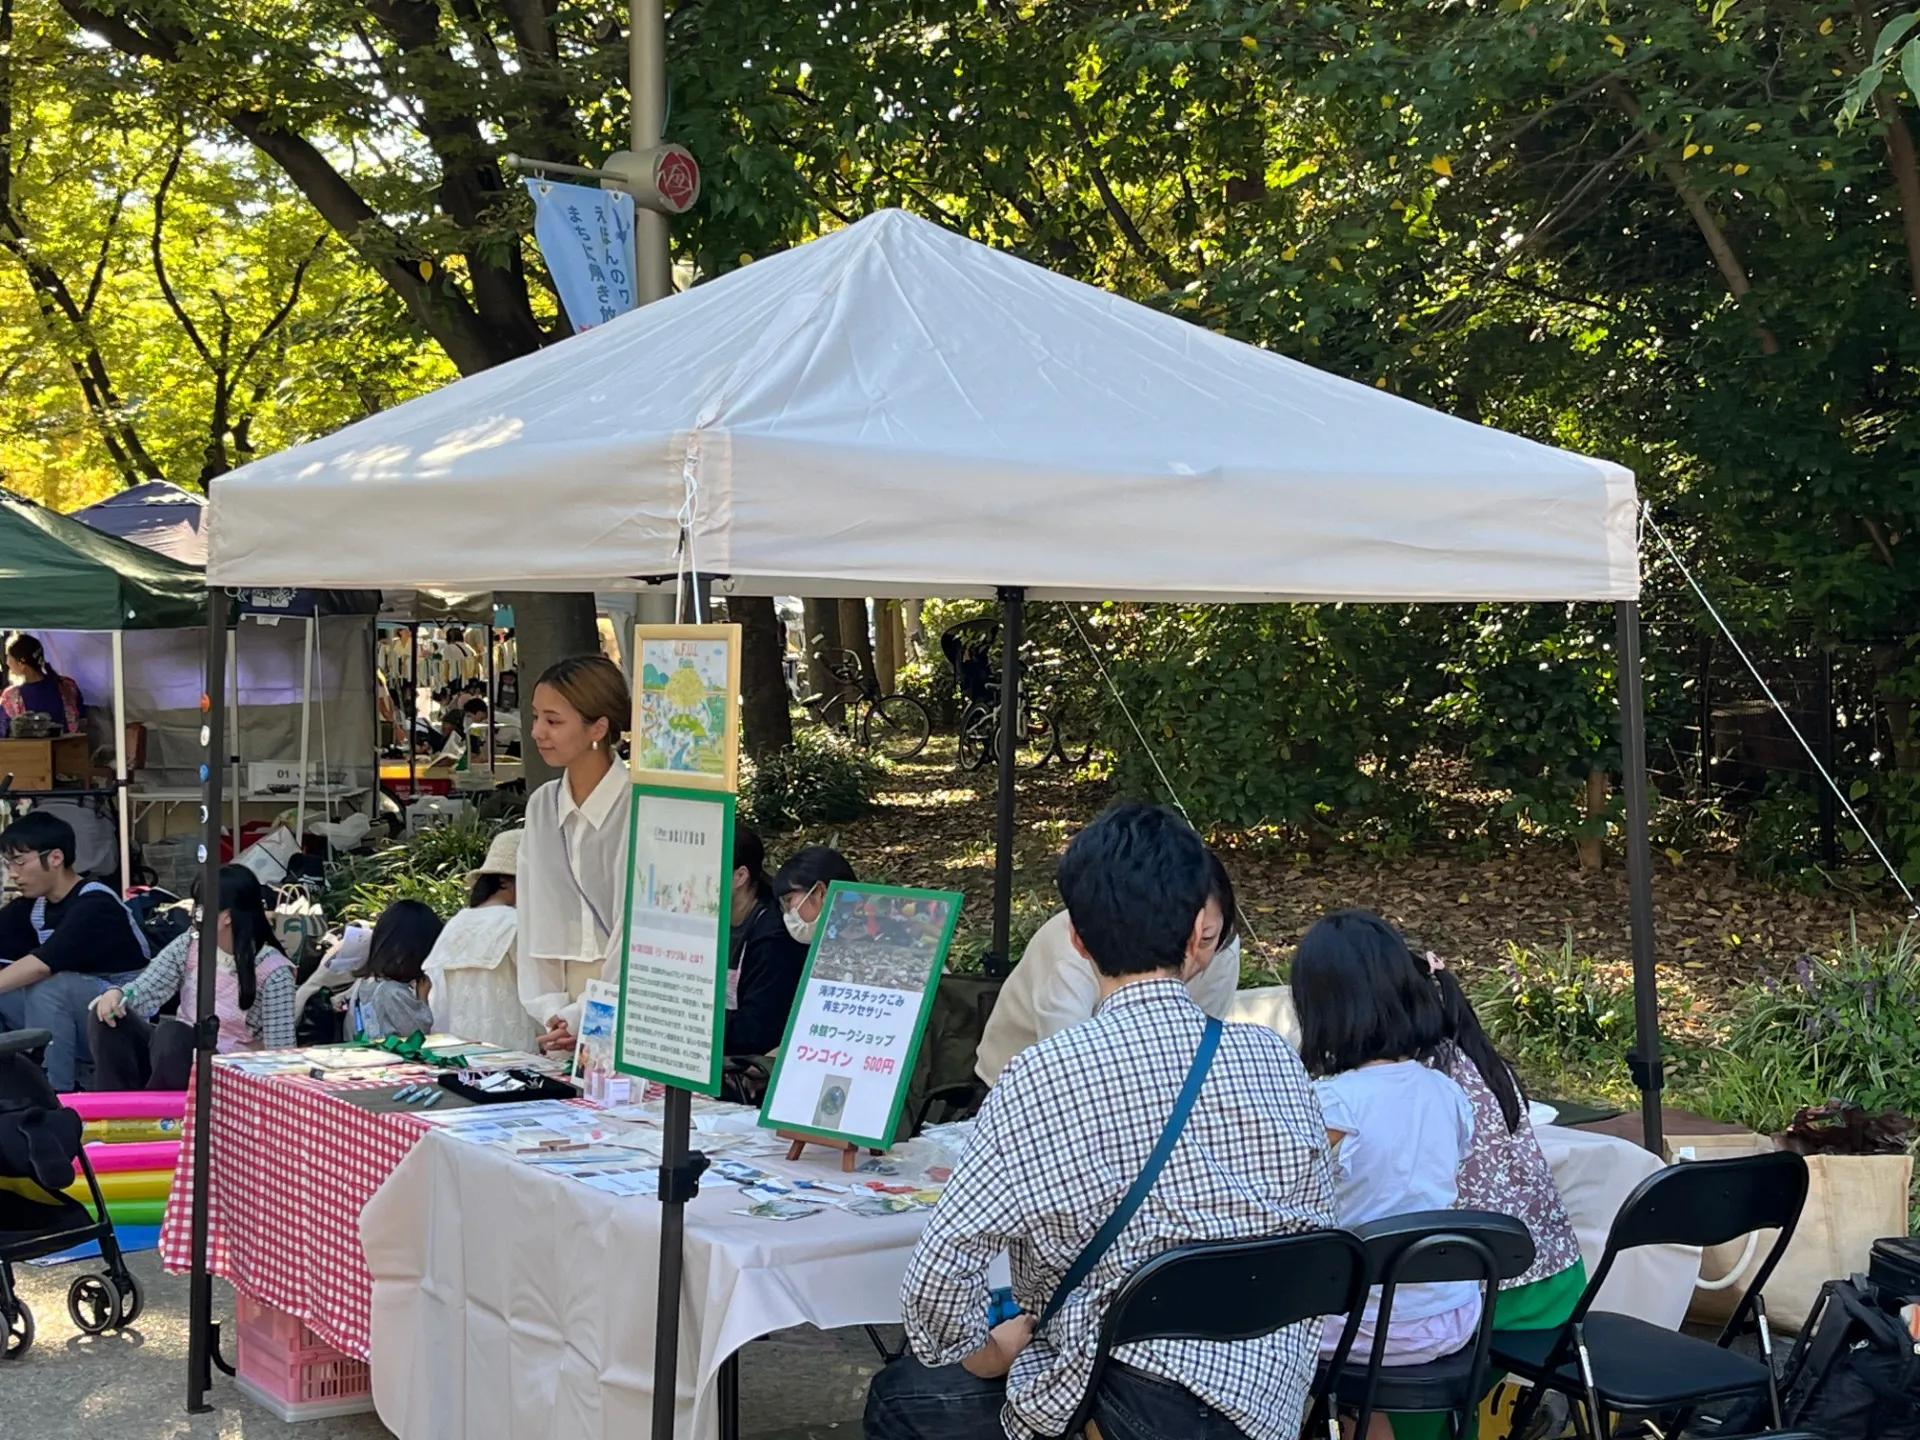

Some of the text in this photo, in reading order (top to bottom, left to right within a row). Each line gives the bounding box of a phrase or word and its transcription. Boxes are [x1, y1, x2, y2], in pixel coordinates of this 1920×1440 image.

[797, 1046, 895, 1074] ワンコイン 500円
